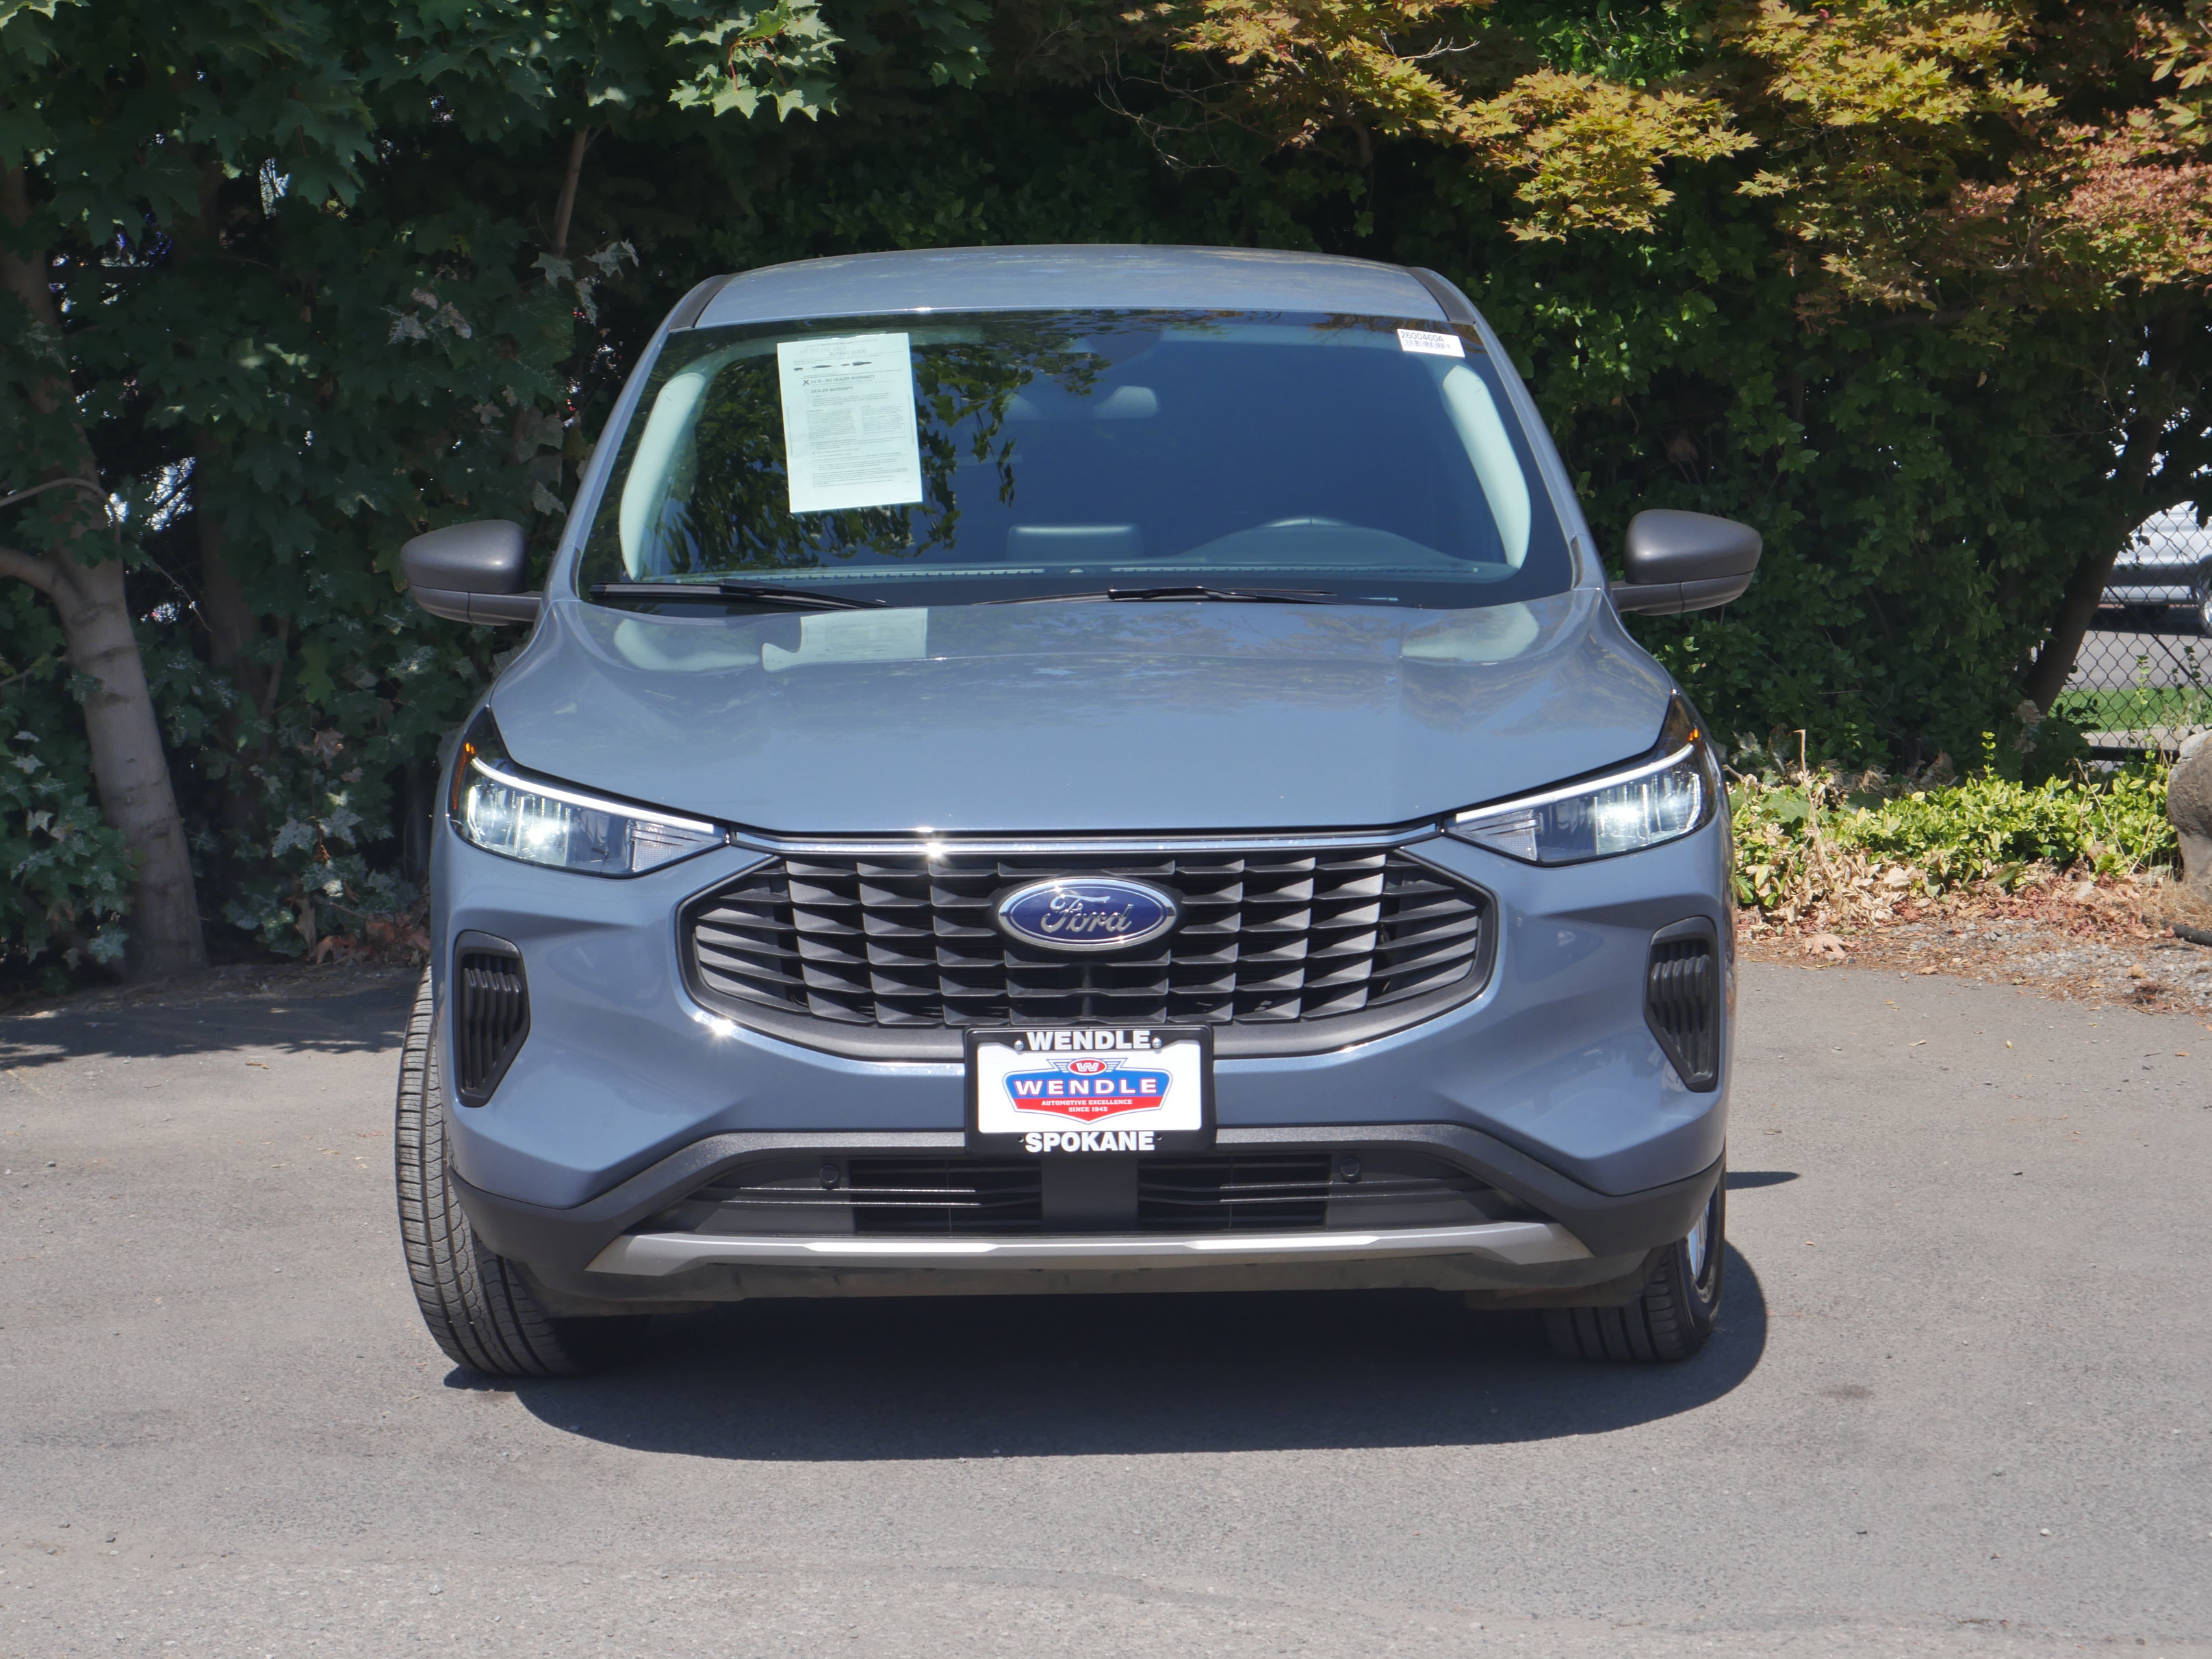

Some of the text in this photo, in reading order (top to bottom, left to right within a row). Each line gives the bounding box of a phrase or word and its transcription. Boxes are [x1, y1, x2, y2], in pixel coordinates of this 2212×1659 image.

[1400, 331, 1444, 343] 2600460A
[1040, 894, 1134, 934] Ford
[1027, 1030, 1151, 1051] WENDLE
[1076, 1062, 1101, 1072] W
[1014, 1079, 1157, 1096] WENDLE
[1025, 1131, 1155, 1153] SPOKANE
